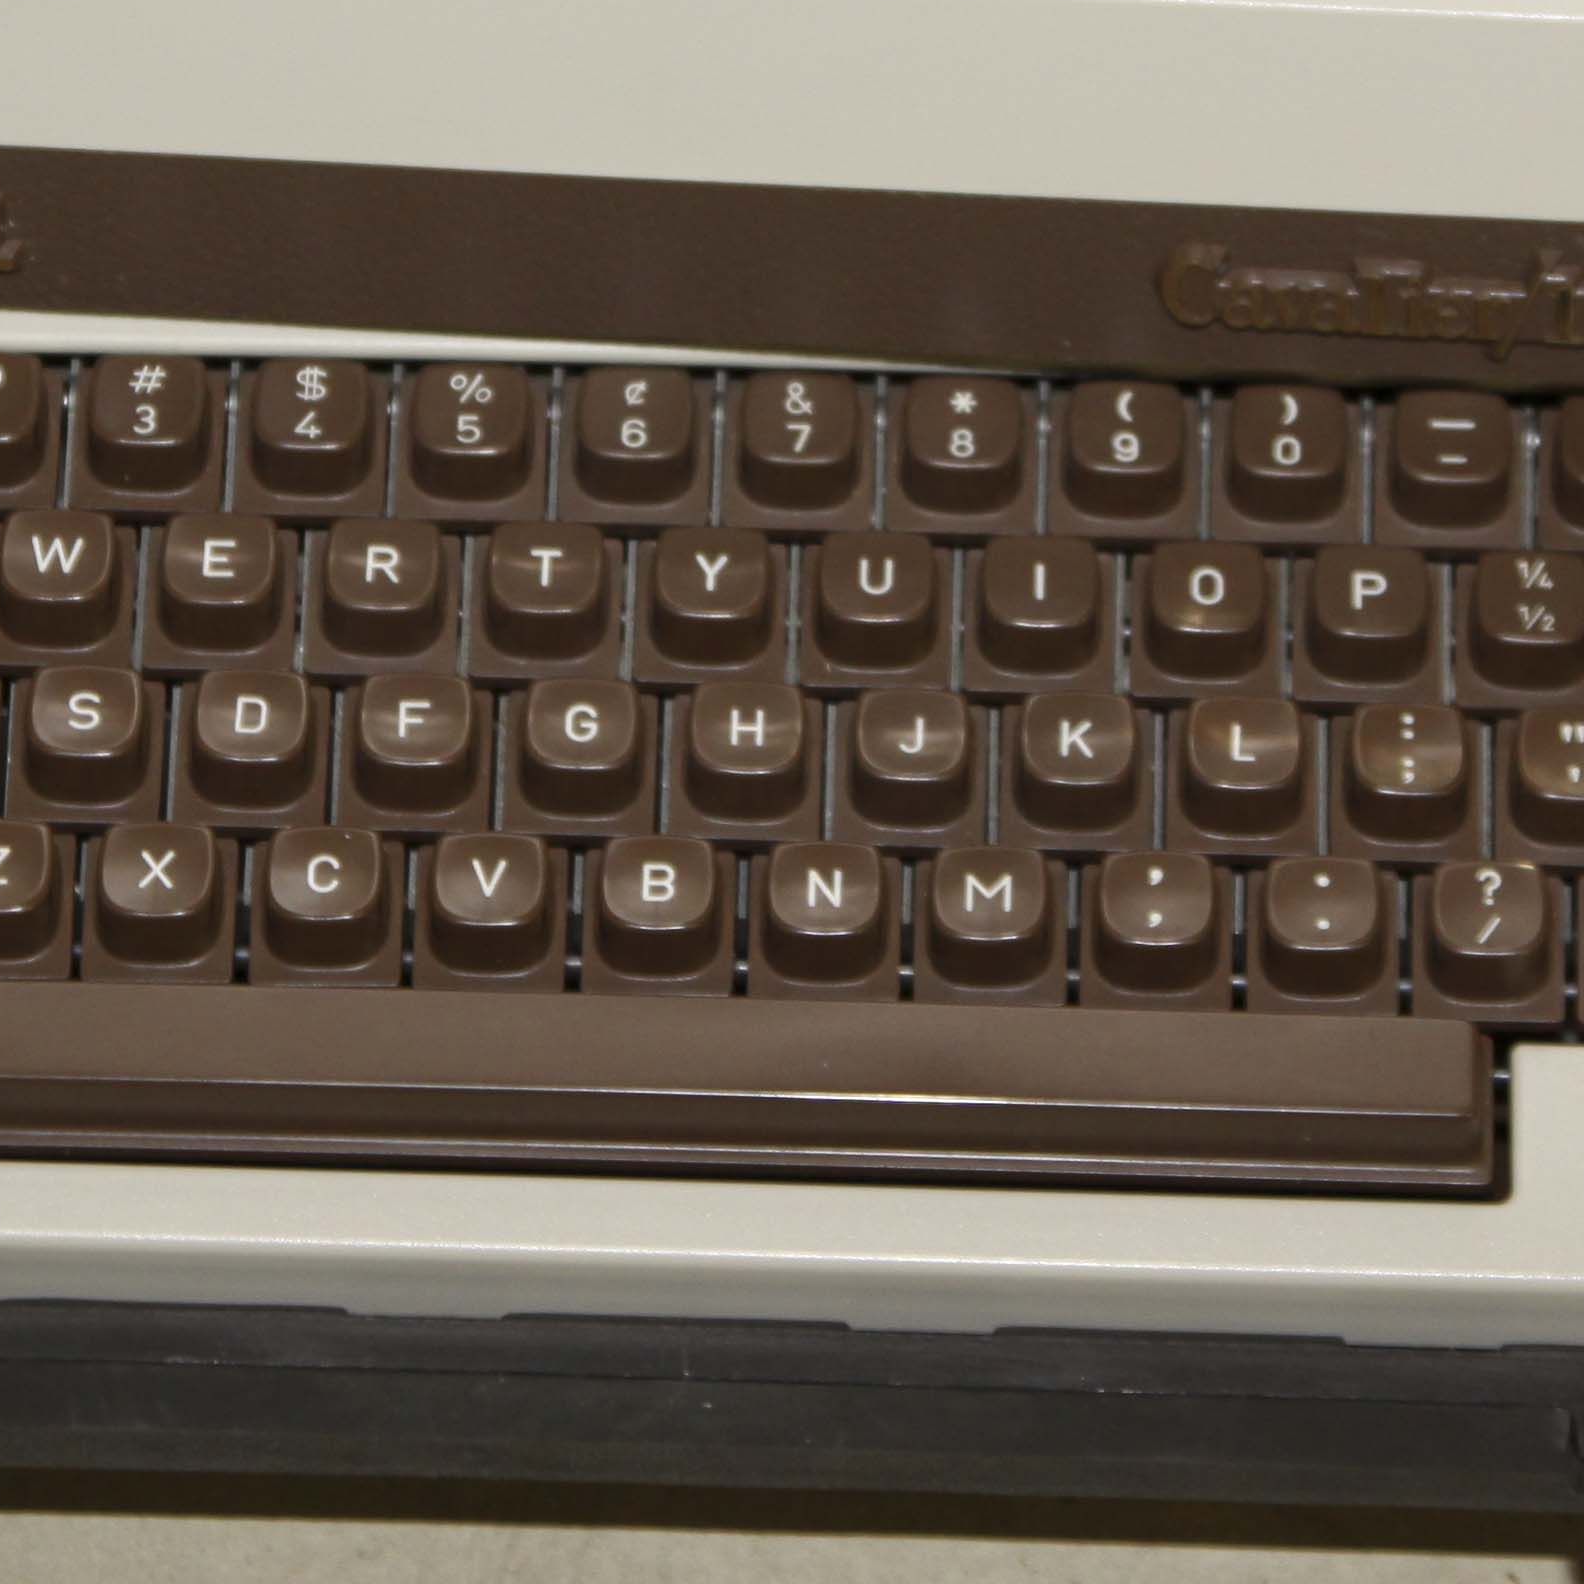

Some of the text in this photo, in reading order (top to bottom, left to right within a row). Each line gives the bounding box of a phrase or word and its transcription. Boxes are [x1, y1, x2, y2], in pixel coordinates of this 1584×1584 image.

[128, 364, 167, 395] #
[295, 365, 328, 402] $
[448, 372, 494, 404] %
[783, 380, 813, 416] &
[132, 403, 158, 436] 3
[293, 410, 323, 440] 4
[1116, 390, 1134, 423] (
[1283, 393, 1299, 426] )
[456, 413, 482, 445] 5
[620, 417, 648, 449] 6
[785, 421, 813, 454] 7
[948, 427, 976, 459] 8
[1112, 431, 1140, 463] 9
[30, 534, 85, 575] W
[201, 538, 237, 578] E
[364, 544, 401, 584] R
[529, 547, 564, 588] T
[694, 552, 729, 593] Y
[858, 557, 895, 597] U
[1033, 562, 1047, 602] I
[1189, 566, 1226, 607] O
[1350, 570, 1389, 611] P
[67, 691, 101, 731] S
[233, 695, 269, 735] D
[396, 700, 432, 739] F
[563, 703, 600, 744] G
[729, 708, 766, 748] H
[898, 716, 927, 755] J
[1059, 720, 1094, 759] K
[1229, 723, 1257, 763] L
[137, 850, 176, 890] X
[305, 854, 341, 894] C
[471, 858, 508, 898] V
[640, 862, 676, 903] B
[806, 868, 843, 909] N
[1476, 867, 1503, 907] ?
[964, 873, 1013, 913] M
